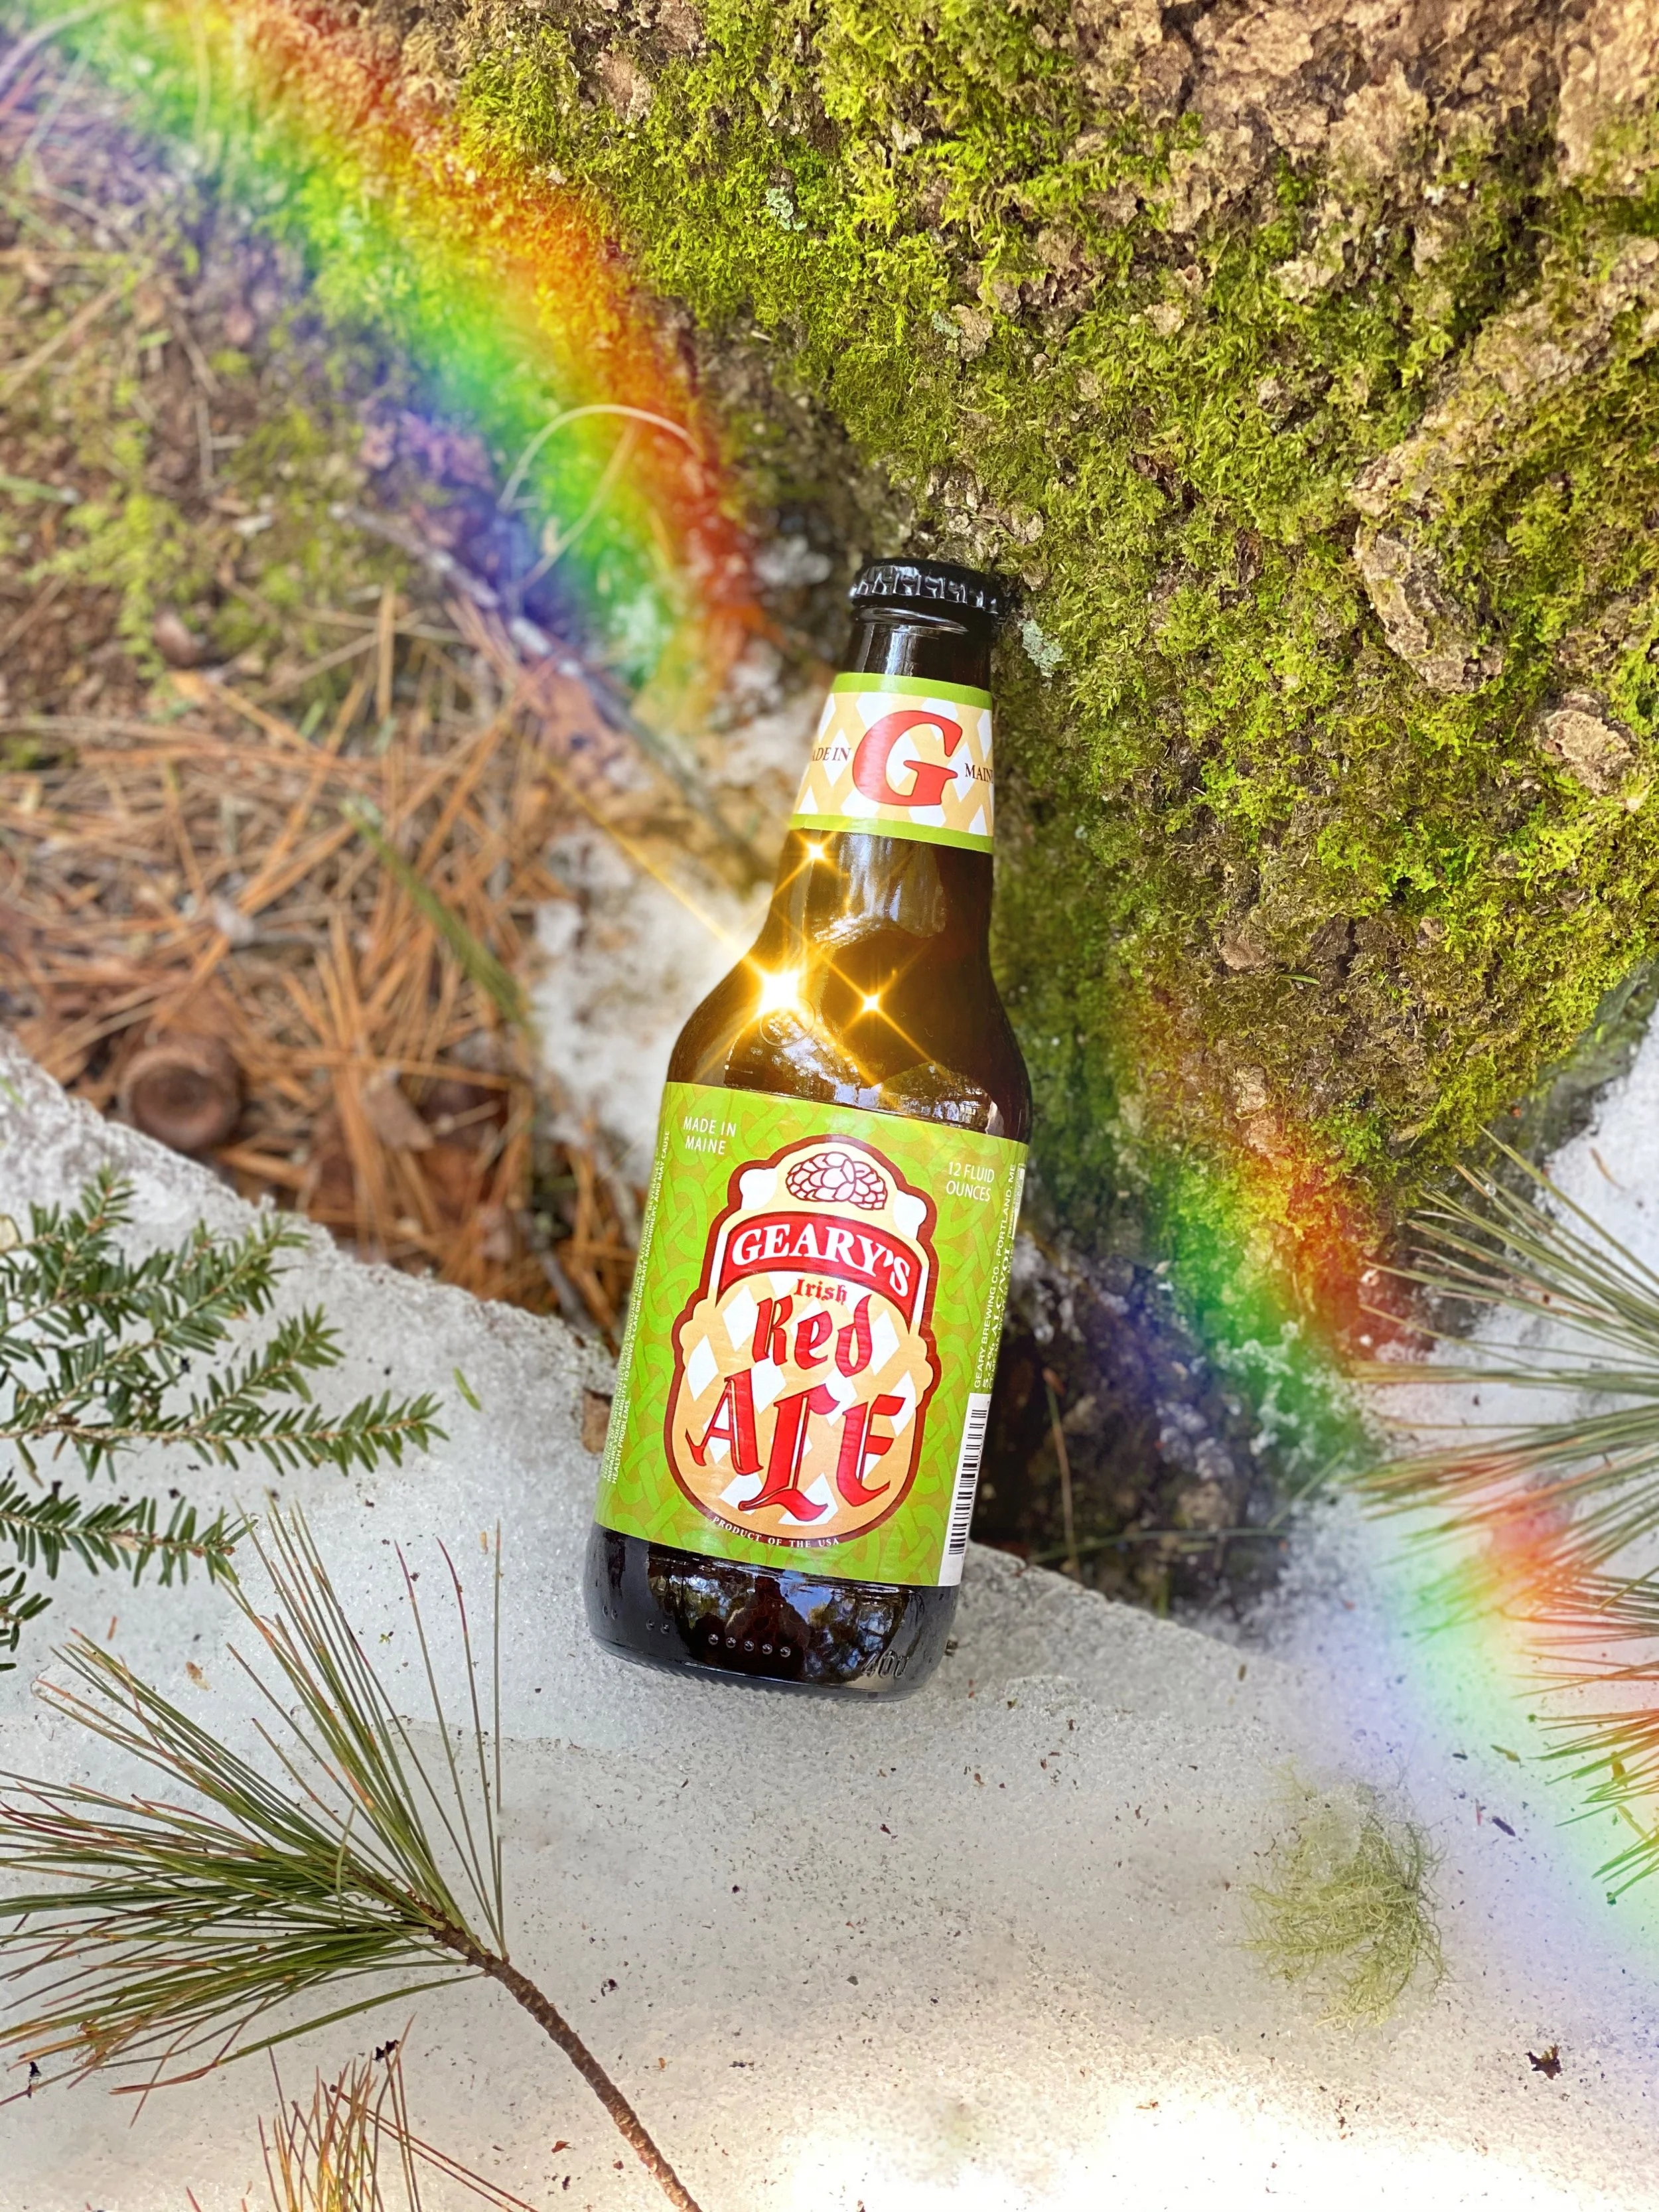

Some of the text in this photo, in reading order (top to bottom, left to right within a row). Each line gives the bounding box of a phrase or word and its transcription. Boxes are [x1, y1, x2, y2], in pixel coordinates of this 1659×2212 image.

[812, 747, 852, 761] ADE IN
[852, 710, 963, 806] G
[964, 763, 993, 783] MAIN
[684, 1116, 737, 1137] MADE IN
[661, 1130, 670, 1159] CAUSE
[685, 1135, 726, 1155] MAINE
[949, 1161, 995, 1183] 12 FLUID
[946, 1180, 991, 1202] OUNCES
[732, 1223, 910, 1297] GEARY'S
[637, 1260, 648, 1298] OPERATE
[974, 1346, 986, 1388] GEARY
[981, 1286, 996, 1344] BREWING
[1008, 1163, 1015, 1183] ME
[634, 1299, 641, 1312] OR
[794, 1278, 848, 1305] Irish
[981, 1243, 1011, 1388] 5.2% ALC/VOL
[752, 1293, 873, 1378] Red
[625, 1342, 634, 1368] DRIVE
[623, 1370, 629, 1380] TO
[617, 1383, 627, 1417] ABILITY
[611, 1449, 622, 1484] HEALTH
[617, 1397, 631, 1447] PROBLEMS.
[685, 1368, 906, 1522] ALE
[607, 1445, 616, 1482] IMPAIRS
[712, 1516, 762, 1542] PRODUCT
[767, 1537, 782, 1546] OF
[818, 1538, 839, 1547] USA
